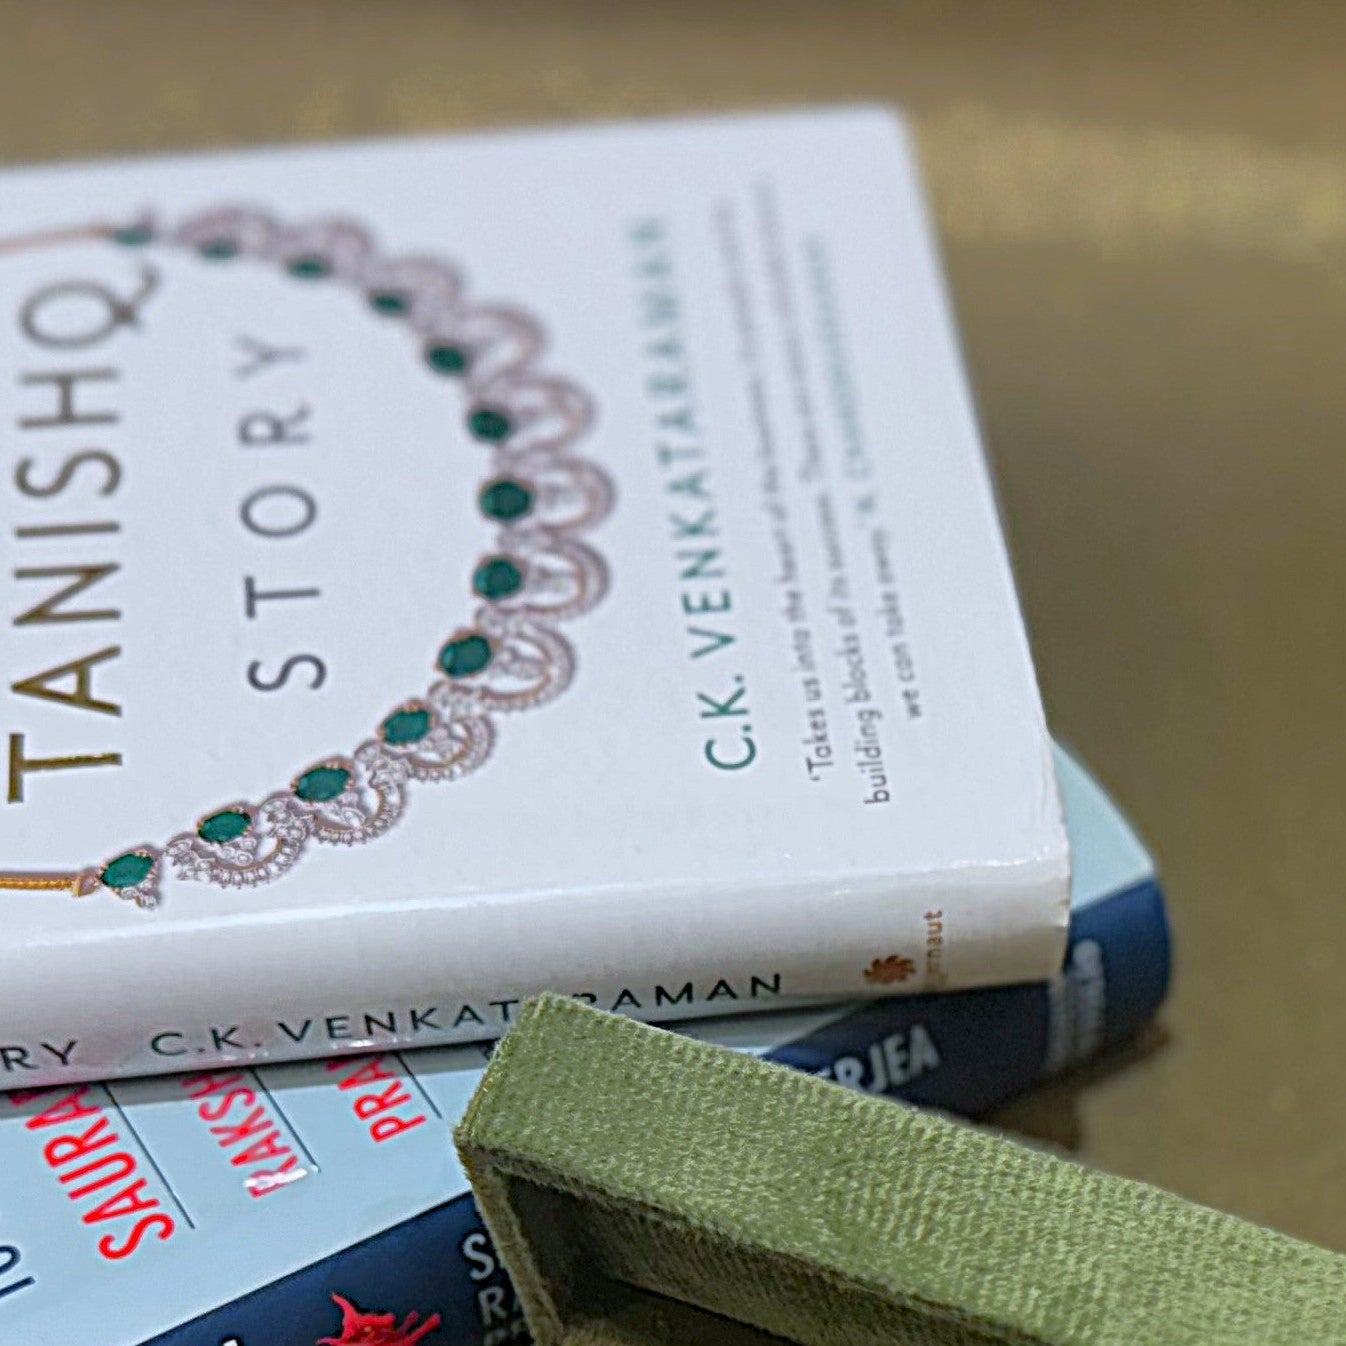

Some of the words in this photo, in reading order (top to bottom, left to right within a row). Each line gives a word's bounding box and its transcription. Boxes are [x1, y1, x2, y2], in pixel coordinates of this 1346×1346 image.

[8, 260, 162, 803] TANISHQ
[235, 335, 327, 692] STORY
[826, 605, 858, 630] of
[891, 642, 916, 682] can
[834, 631, 872, 705] blocks
[900, 688, 923, 720] we
[695, 672, 758, 772] C.K.
[851, 708, 891, 804] building
[1, 1040, 78, 1071] RY
[151, 1024, 262, 1057] C.K.
[279, 973, 782, 1043] VENKATAMAN
[813, 1023, 942, 1093] RJEA
[326, 1057, 427, 1144] PRA
[9, 1082, 175, 1261] SAURA
